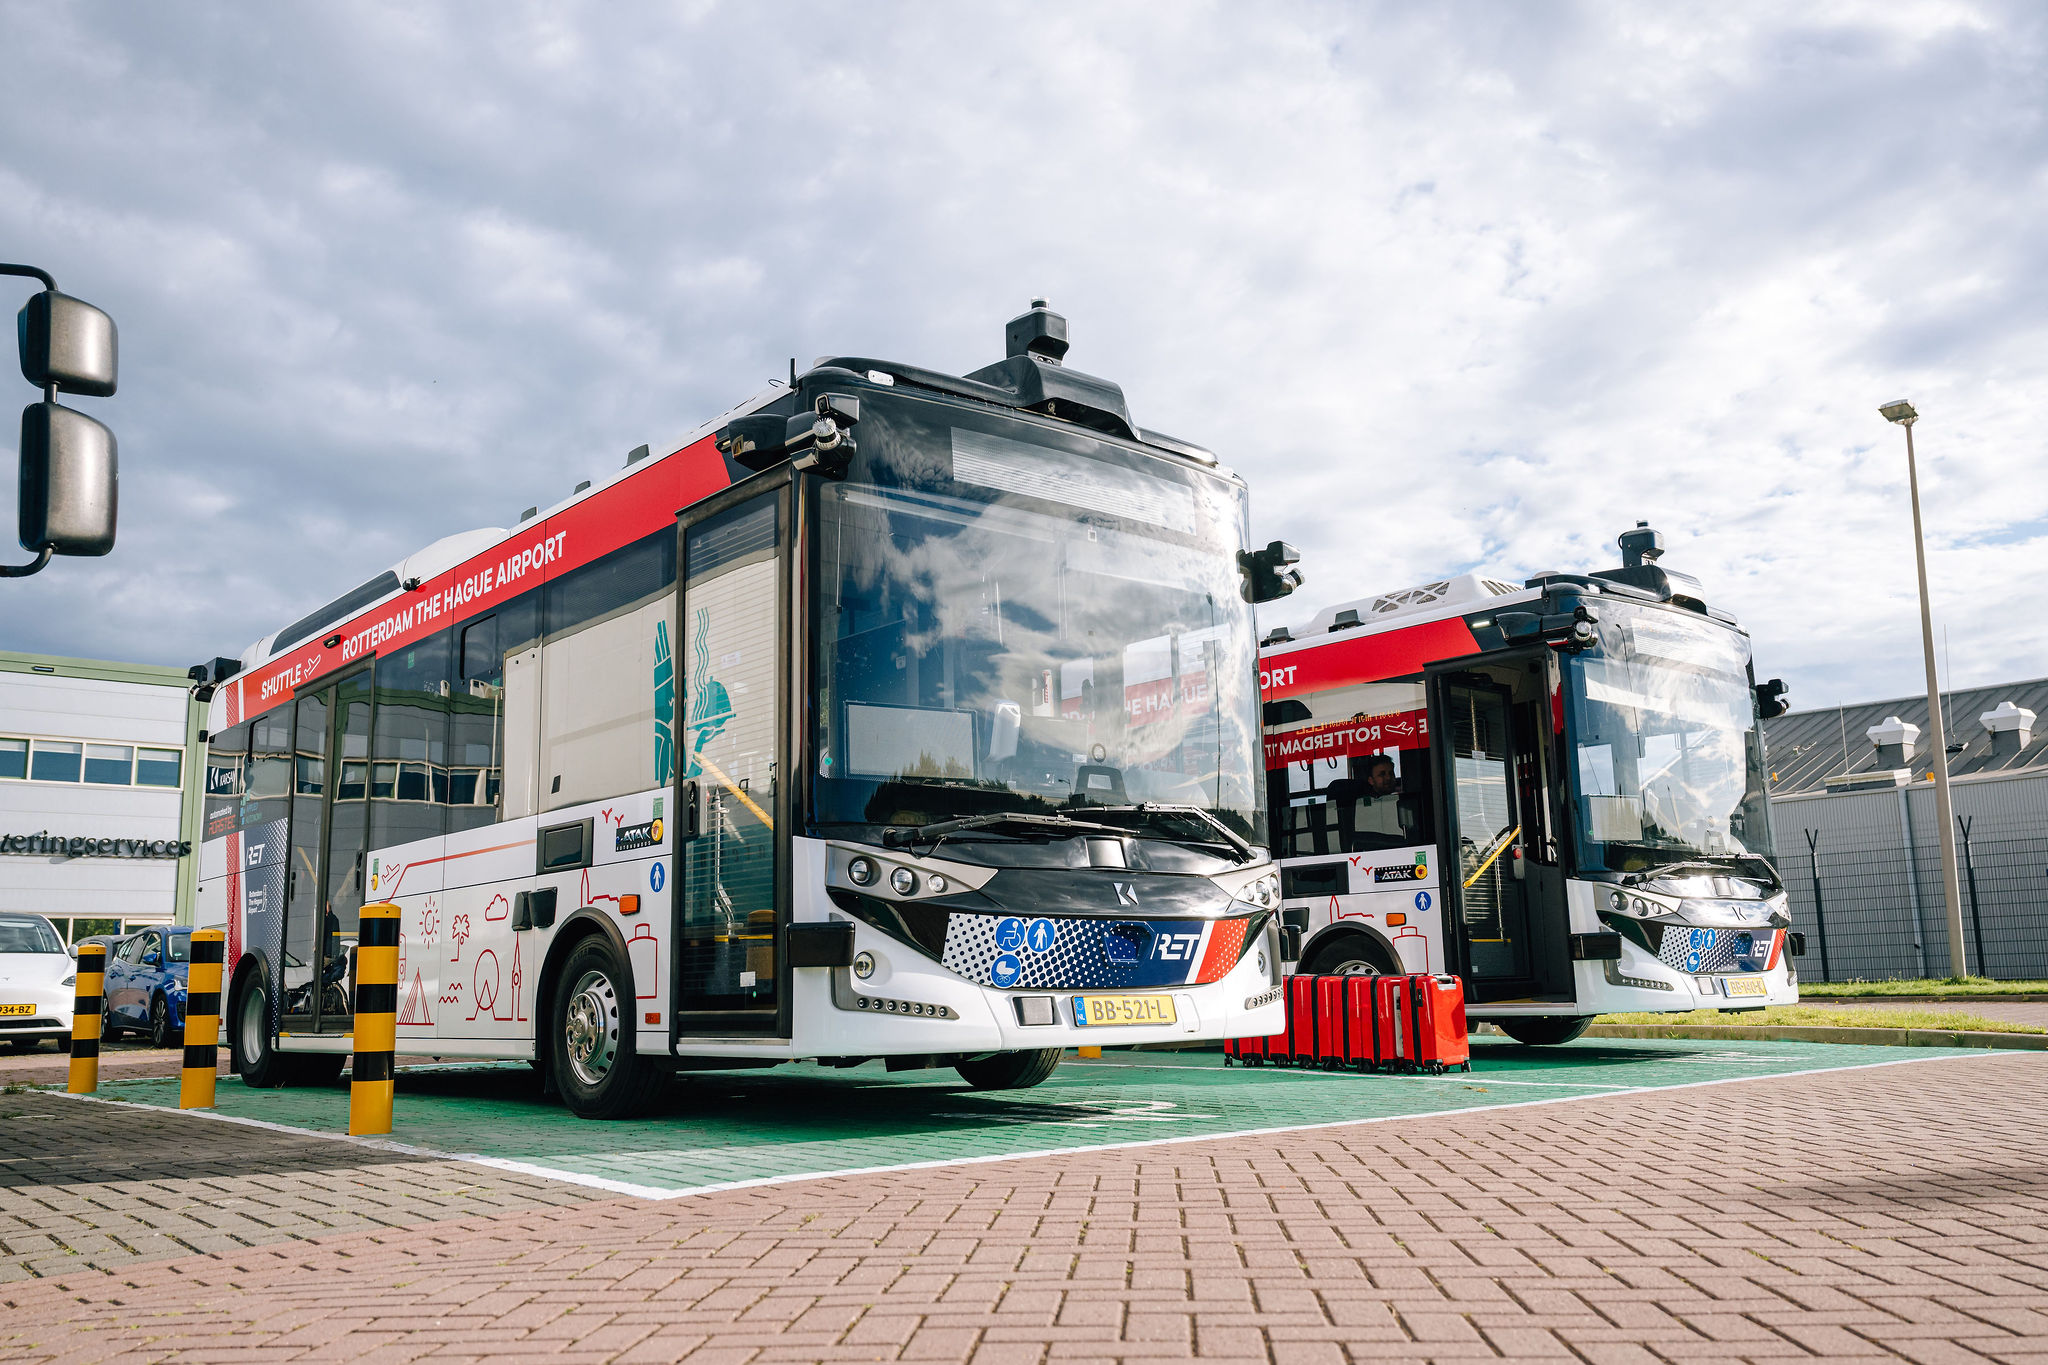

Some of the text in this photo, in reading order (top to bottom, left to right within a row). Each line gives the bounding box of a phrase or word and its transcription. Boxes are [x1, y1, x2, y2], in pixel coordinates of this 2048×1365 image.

[342, 530, 567, 661] ROTTERDAM THE HAGUE AIRPORT
[261, 663, 301, 700] SHUTTLE
[246, 843, 265, 866] RET
[1150, 933, 1201, 960] RET
[1750, 940, 1771, 957] RET
[1092, 999, 1168, 1021] BB-521-L
